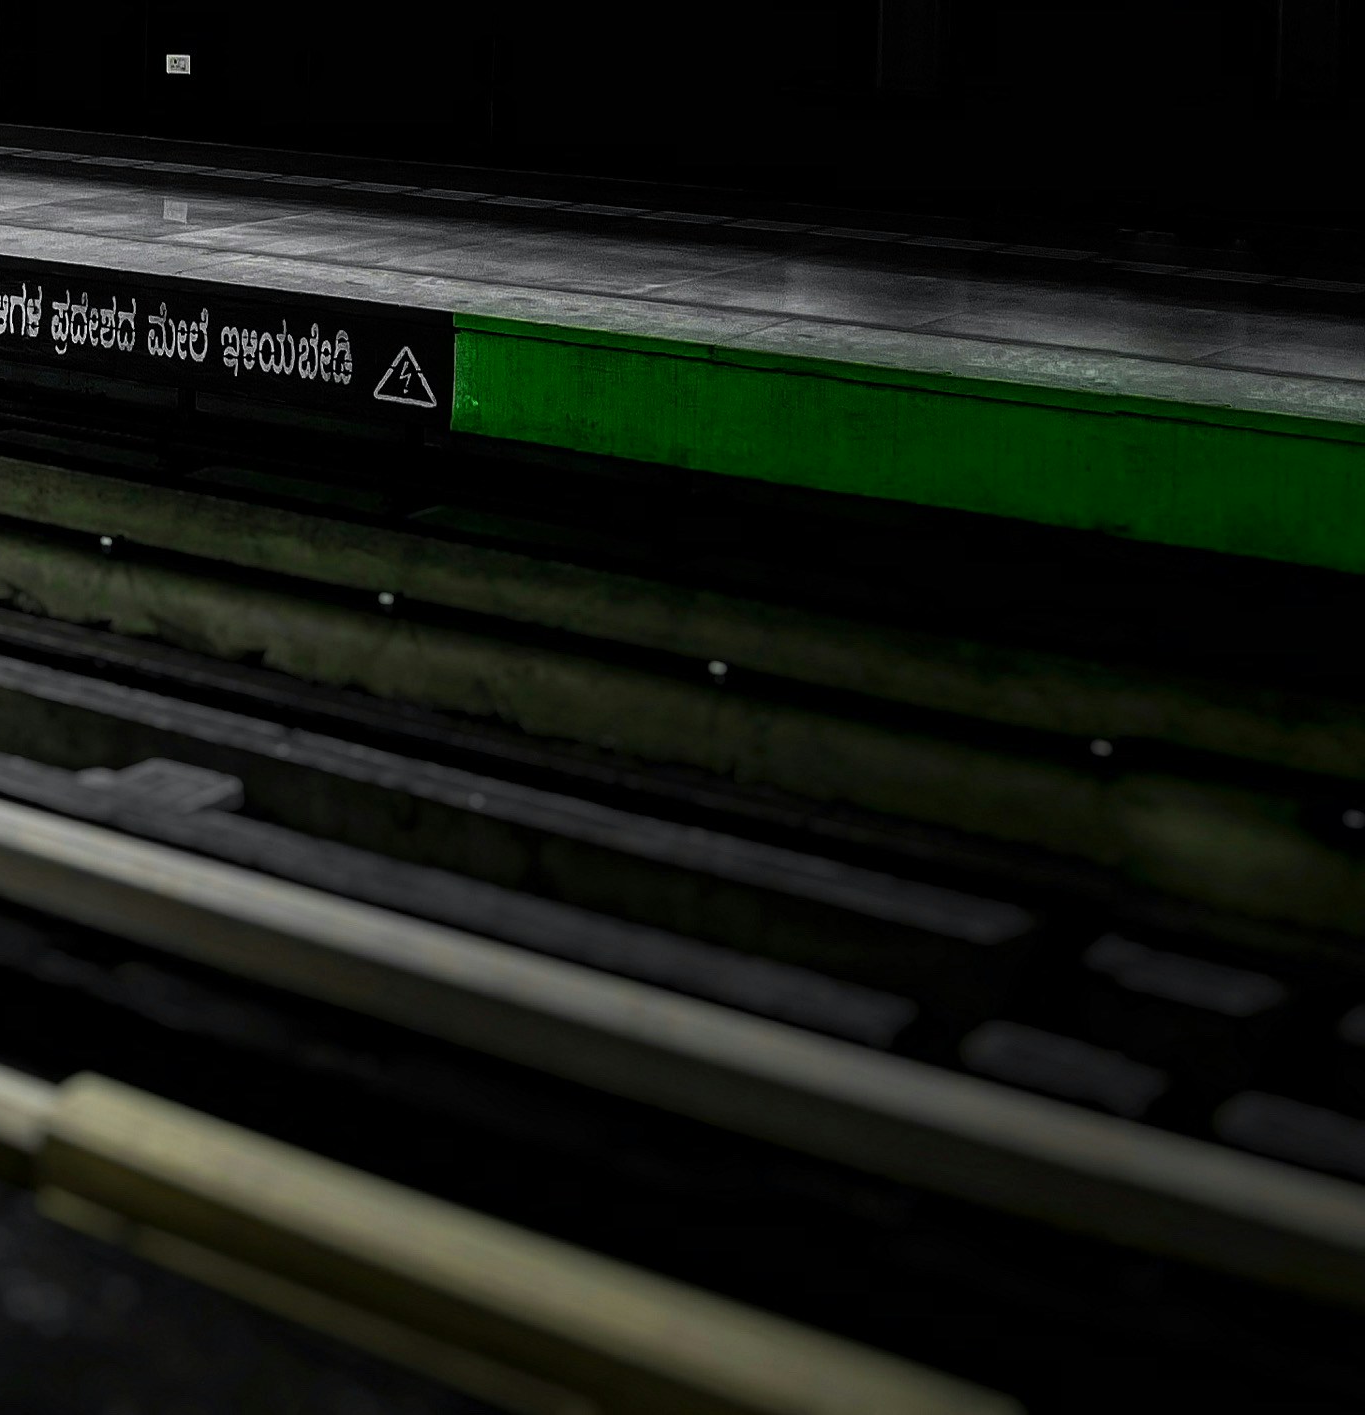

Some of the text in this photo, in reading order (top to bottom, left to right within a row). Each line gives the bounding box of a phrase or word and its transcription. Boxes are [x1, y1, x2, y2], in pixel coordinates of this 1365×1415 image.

[51, 290, 136, 354] ಪ್ರದೇಶದ
[148, 302, 208, 362] ಮೇಲೆ
[221, 319, 352, 384] ಇಳಿಯಬೇಡಿ
